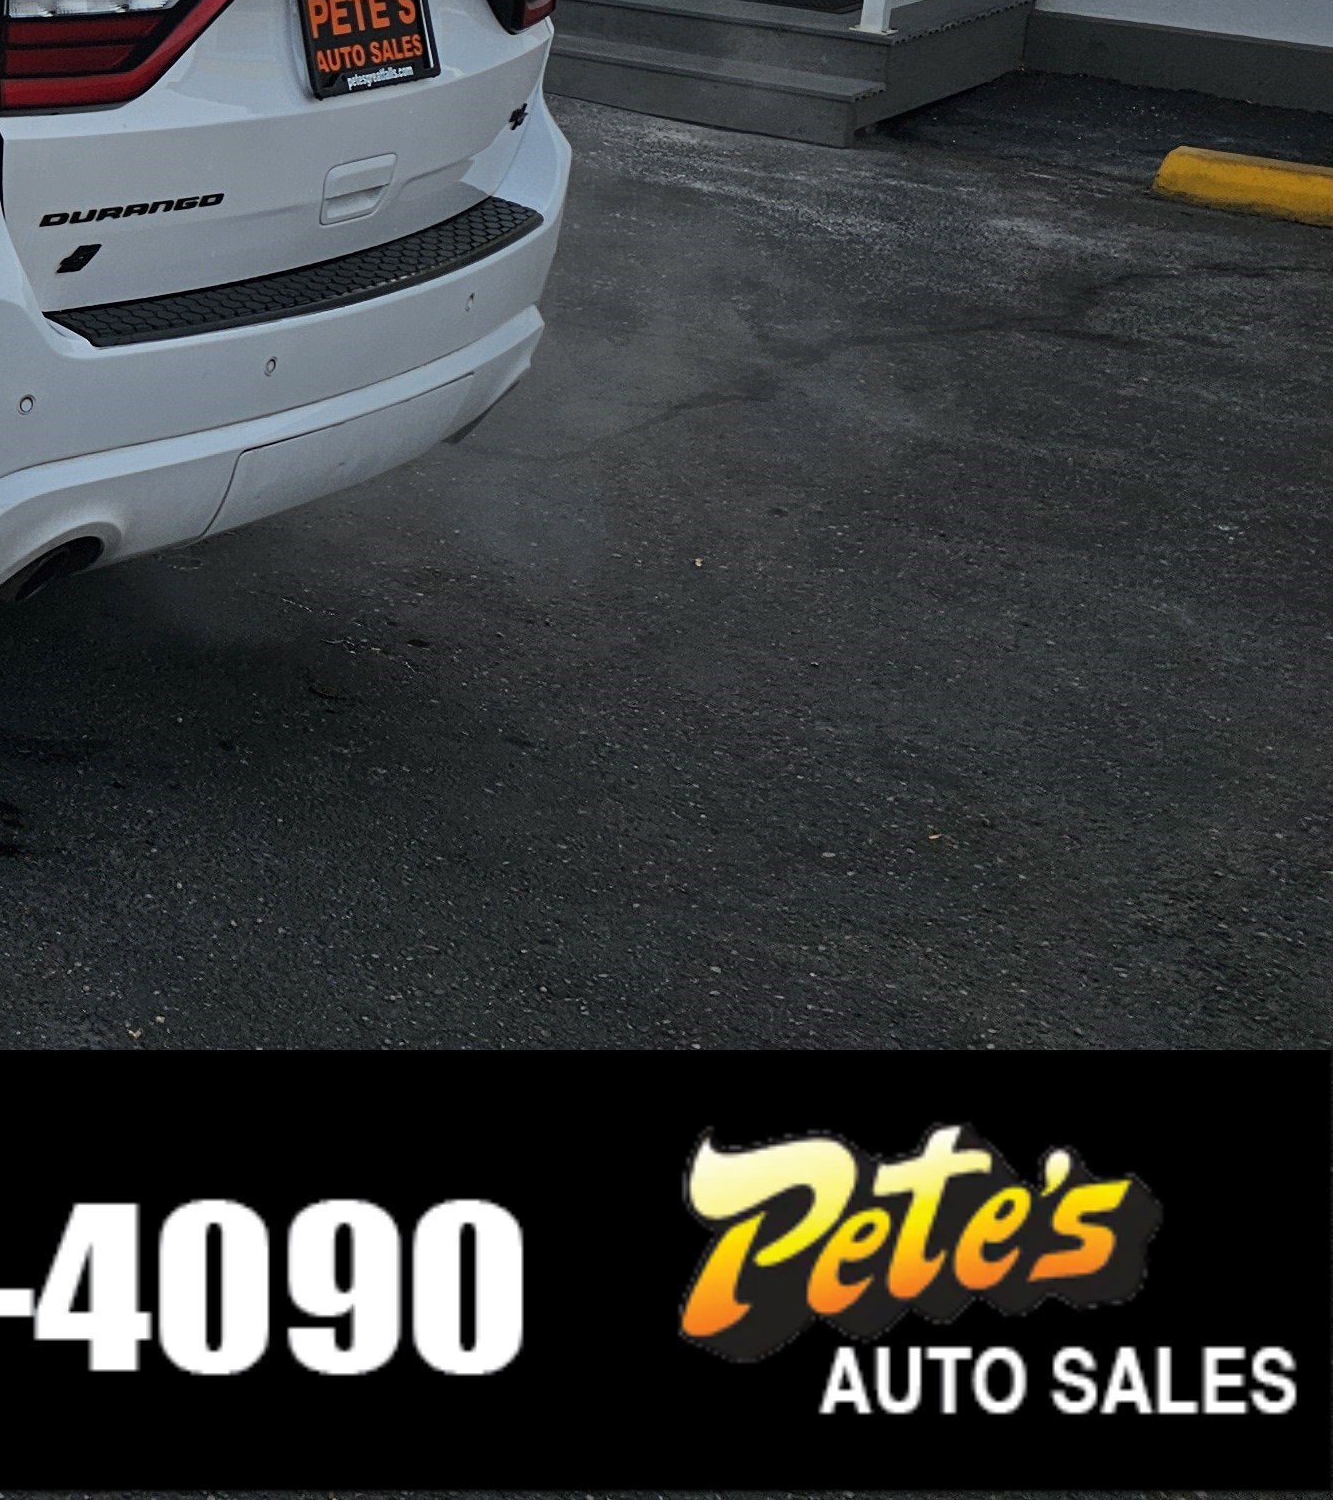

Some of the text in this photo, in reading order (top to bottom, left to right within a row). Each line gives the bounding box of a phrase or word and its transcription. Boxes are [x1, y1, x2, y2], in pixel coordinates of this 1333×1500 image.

[316, 34, 423, 73] AUTO SALES
[39, 193, 225, 227] DURANGO
